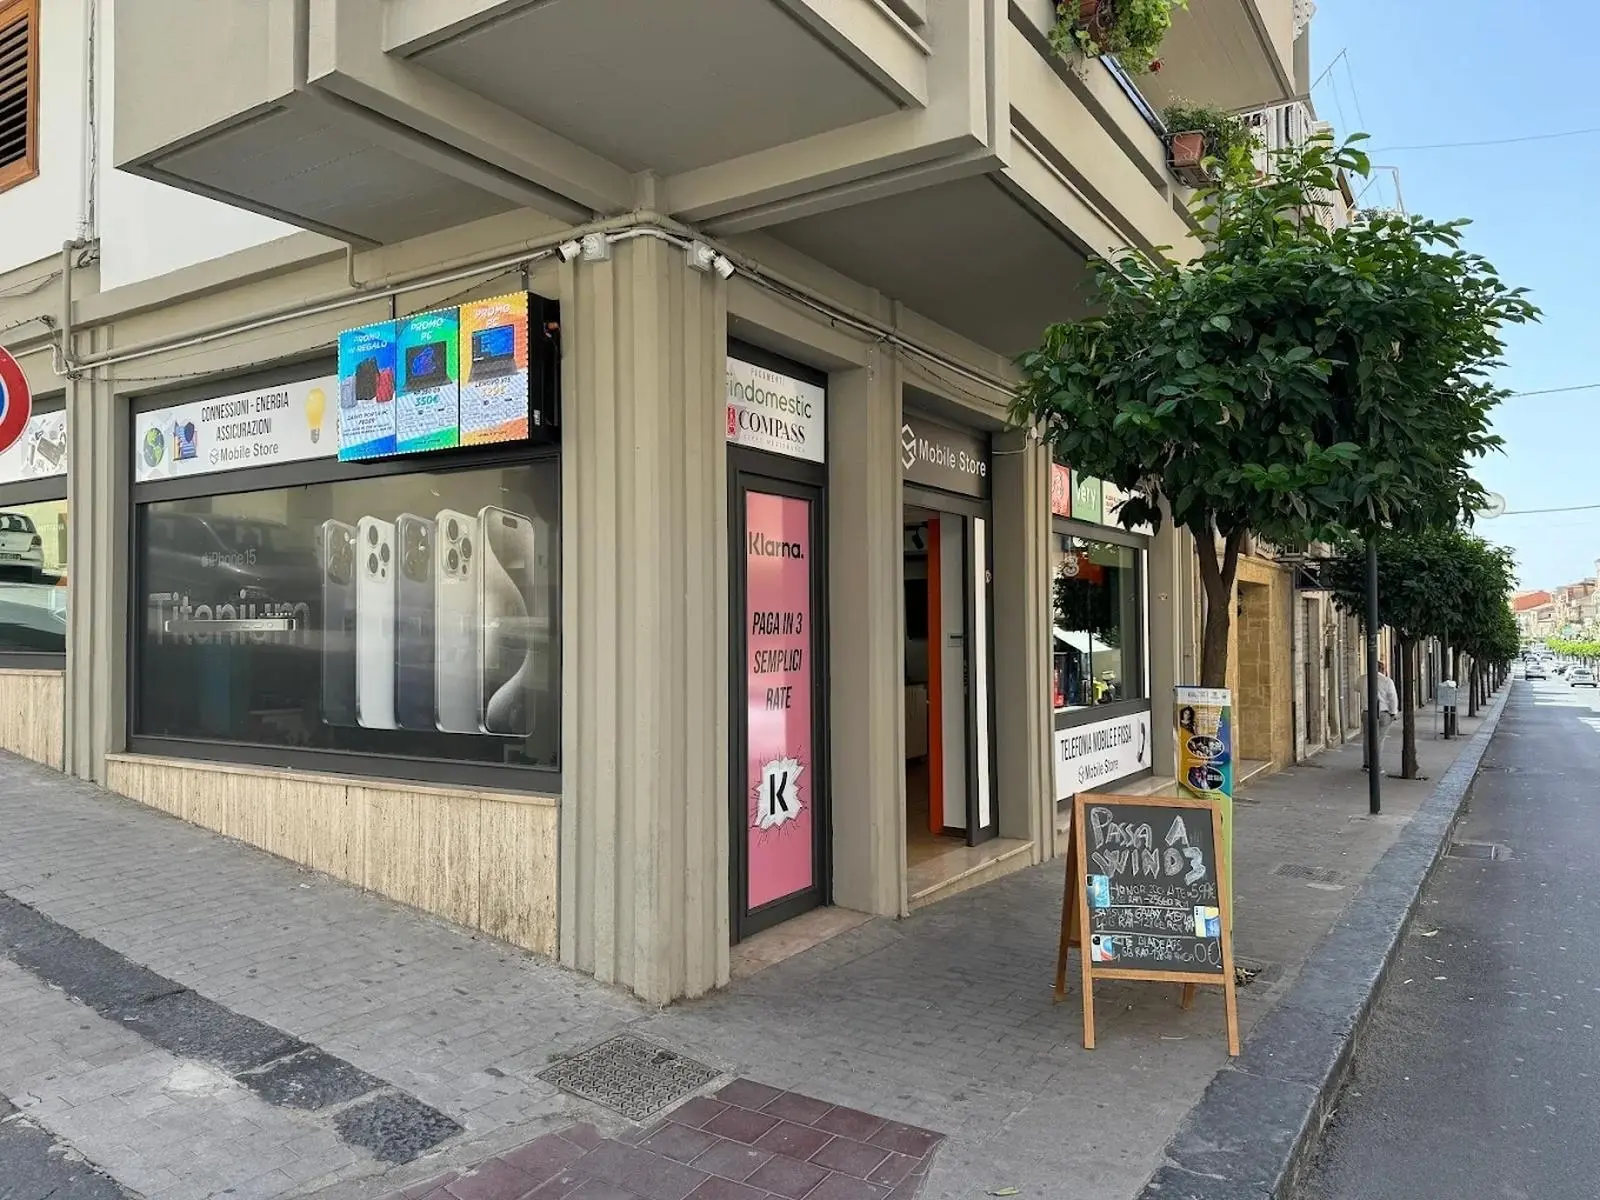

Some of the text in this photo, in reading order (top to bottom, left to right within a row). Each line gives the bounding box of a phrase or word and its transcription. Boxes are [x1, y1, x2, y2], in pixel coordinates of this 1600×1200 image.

[410, 317, 444, 331] PROMO
[356, 340, 388, 353] REGALO
[201, 399, 249, 422] CONNESSIONI
[256, 391, 289, 413] ENERGIA
[415, 394, 440, 407] 350€
[726, 377, 811, 419] indomestic
[216, 417, 272, 442] ASSICURAZIONI
[738, 408, 806, 444] COMPASS
[220, 442, 279, 462] Mobile Store
[919, 438, 986, 477] Mobile Store
[244, 548, 257, 566] 15
[748, 531, 804, 560] Klarna.
[149, 589, 311, 646] Titanium
[752, 611, 803, 636] PAGA IN 3
[753, 648, 802, 674] SEMPLICI
[765, 685, 792, 712] RATE
[1060, 732, 1092, 762] TELEFONIA
[1092, 728, 1113, 753] MOBILE
[1118, 723, 1132, 746] FISSA
[1084, 757, 1119, 781] Mobile Store
[769, 771, 789, 816] K
[1090, 806, 1190, 849] PASSA A
